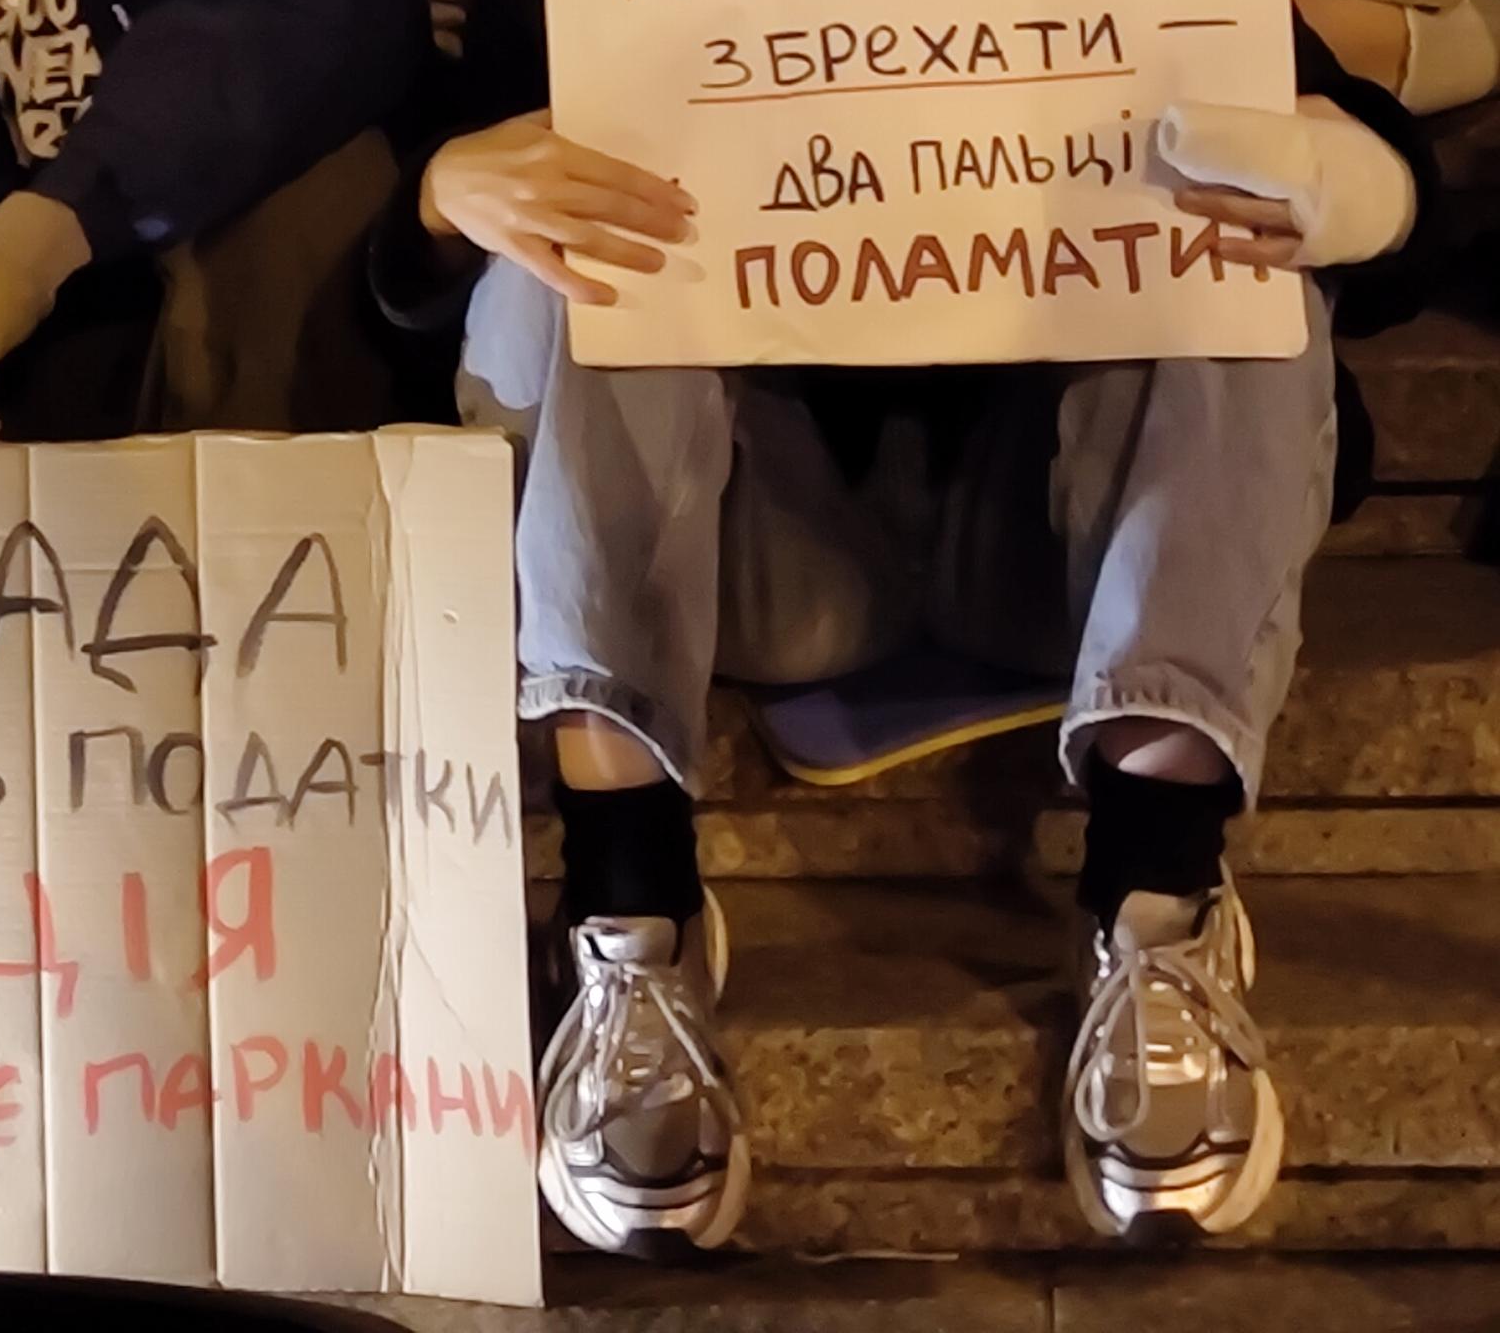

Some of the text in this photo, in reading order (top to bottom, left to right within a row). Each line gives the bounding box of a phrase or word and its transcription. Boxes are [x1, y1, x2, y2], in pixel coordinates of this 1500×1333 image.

[760, 109, 1134, 212] ДВА ПАЛЬЦІ
[68, 727, 518, 849] ПОДАТКИ
[83, 1035, 540, 1152] ПАРКАНИ
